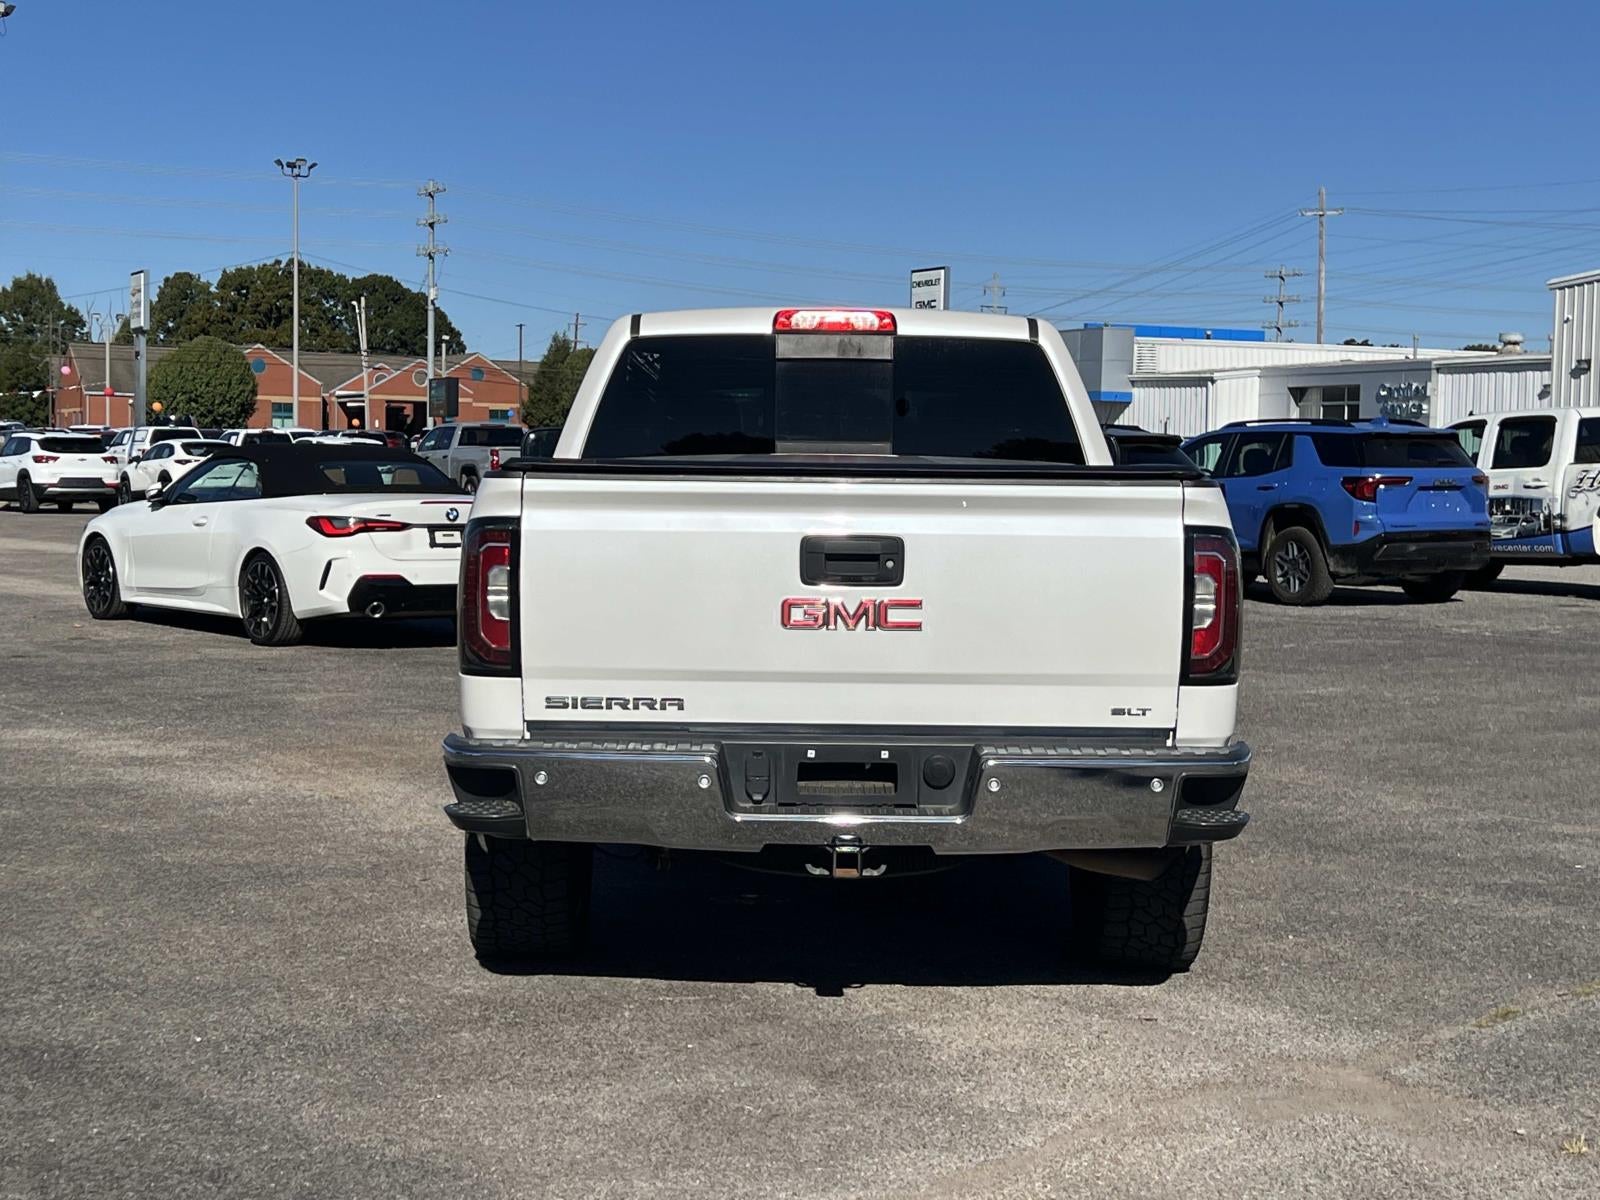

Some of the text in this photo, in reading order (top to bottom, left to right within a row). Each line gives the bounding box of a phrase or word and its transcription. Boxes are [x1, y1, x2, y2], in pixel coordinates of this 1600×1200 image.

[915, 299, 937, 310] GMC
[781, 598, 923, 631] GMC
[544, 696, 685, 711] SIERRA
[1111, 707, 1152, 717] SLT
